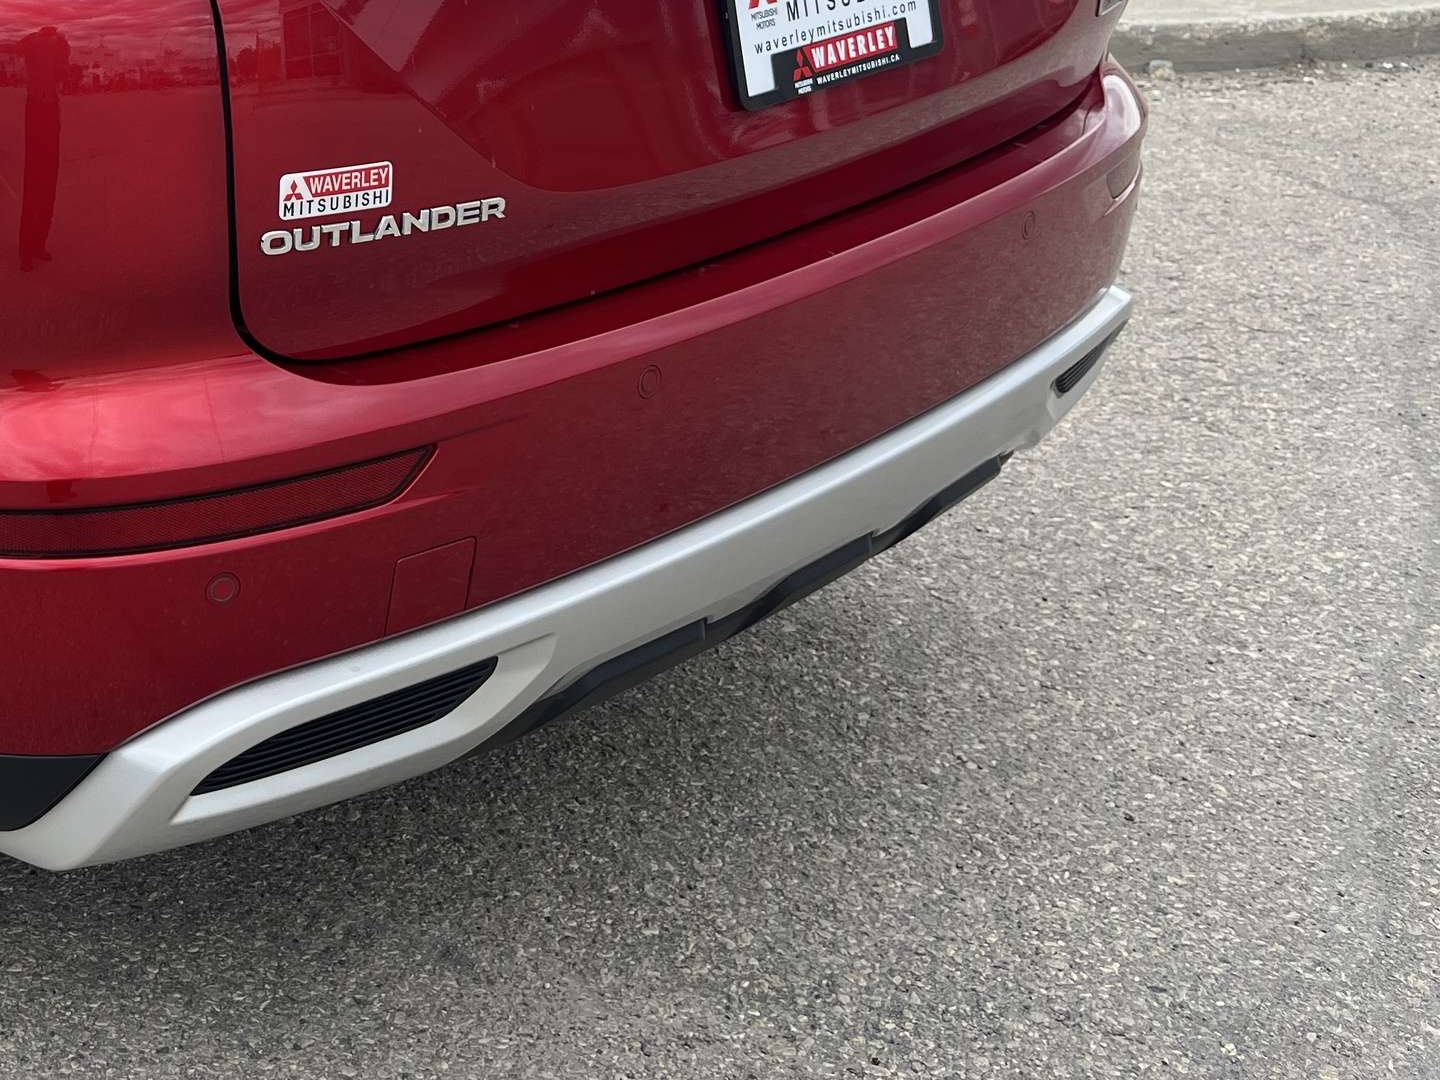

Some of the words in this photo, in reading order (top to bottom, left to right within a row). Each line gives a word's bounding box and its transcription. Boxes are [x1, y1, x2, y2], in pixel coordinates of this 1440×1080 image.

[754, 0, 917, 54] waverleymitsubishi.com
[811, 26, 895, 69] WAVERLEY
[816, 53, 900, 85] WAVERLEYMITSUBISHI.CA
[309, 168, 389, 195] WAVERLEY
[283, 188, 389, 218] MITSUBISHI
[261, 196, 506, 256] OUTLANDER
